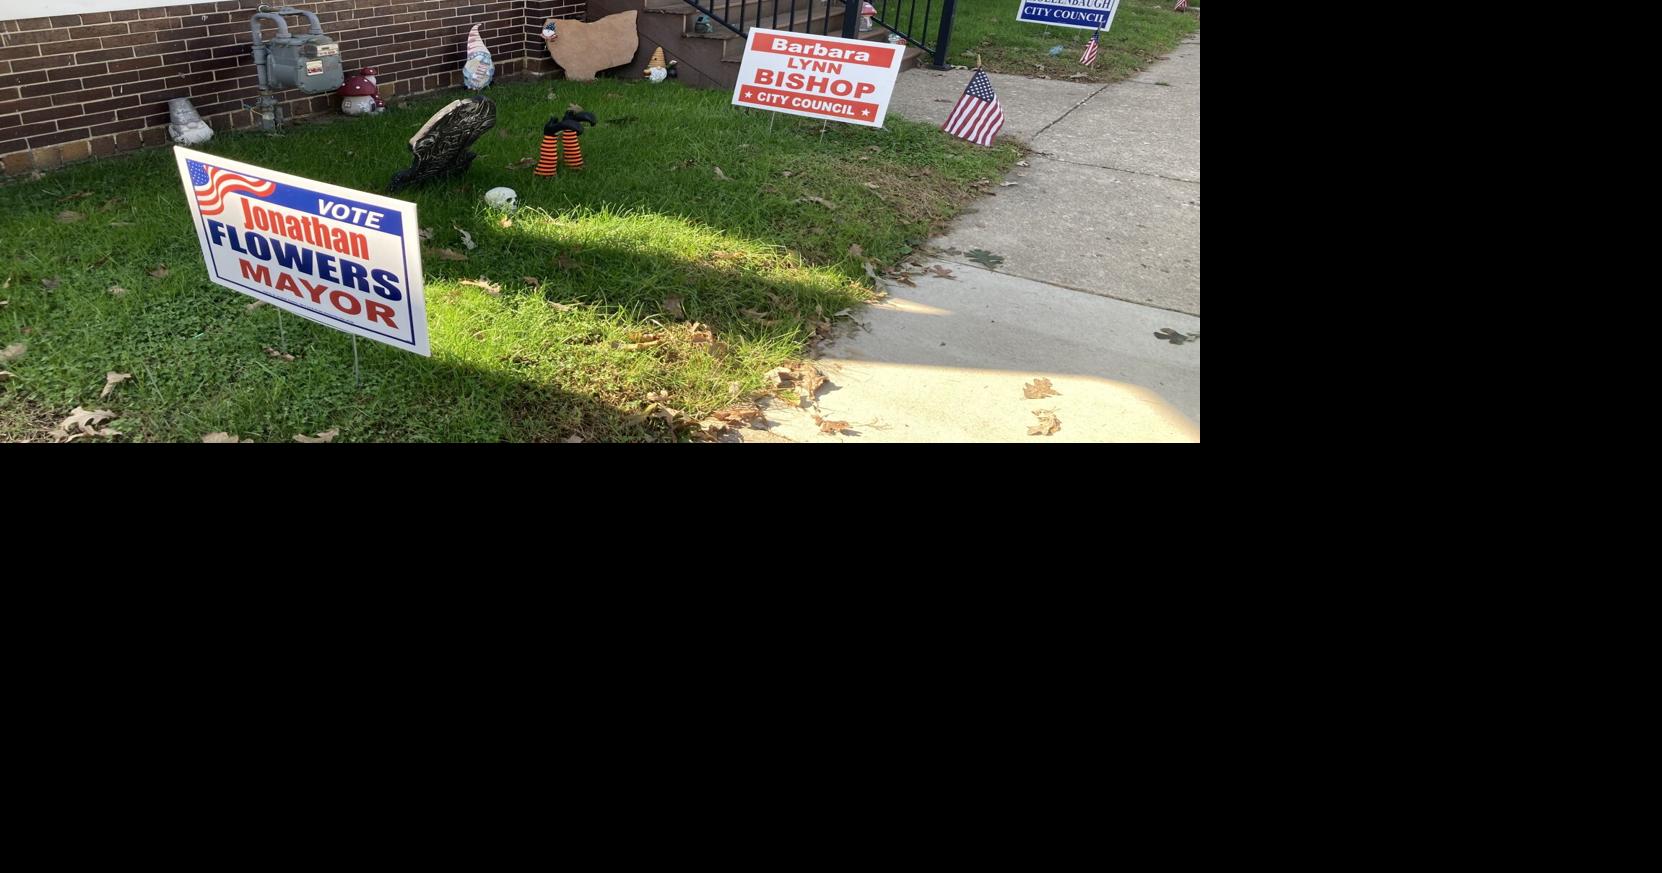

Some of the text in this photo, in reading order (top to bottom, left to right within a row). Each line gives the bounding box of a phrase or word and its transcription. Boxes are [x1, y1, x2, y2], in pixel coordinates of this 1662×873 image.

[1024, 6, 1106, 23] CITY COUNCIL
[771, 37, 870, 62] Barbara
[786, 57, 843, 75] LYNN
[754, 68, 876, 99] BISHOP
[757, 91, 855, 116] CITY COUNCIL
[240, 197, 370, 261] Jonathan
[318, 198, 385, 229] VOTE
[207, 218, 403, 302] FLOWERS
[239, 258, 399, 330] MAYOR
